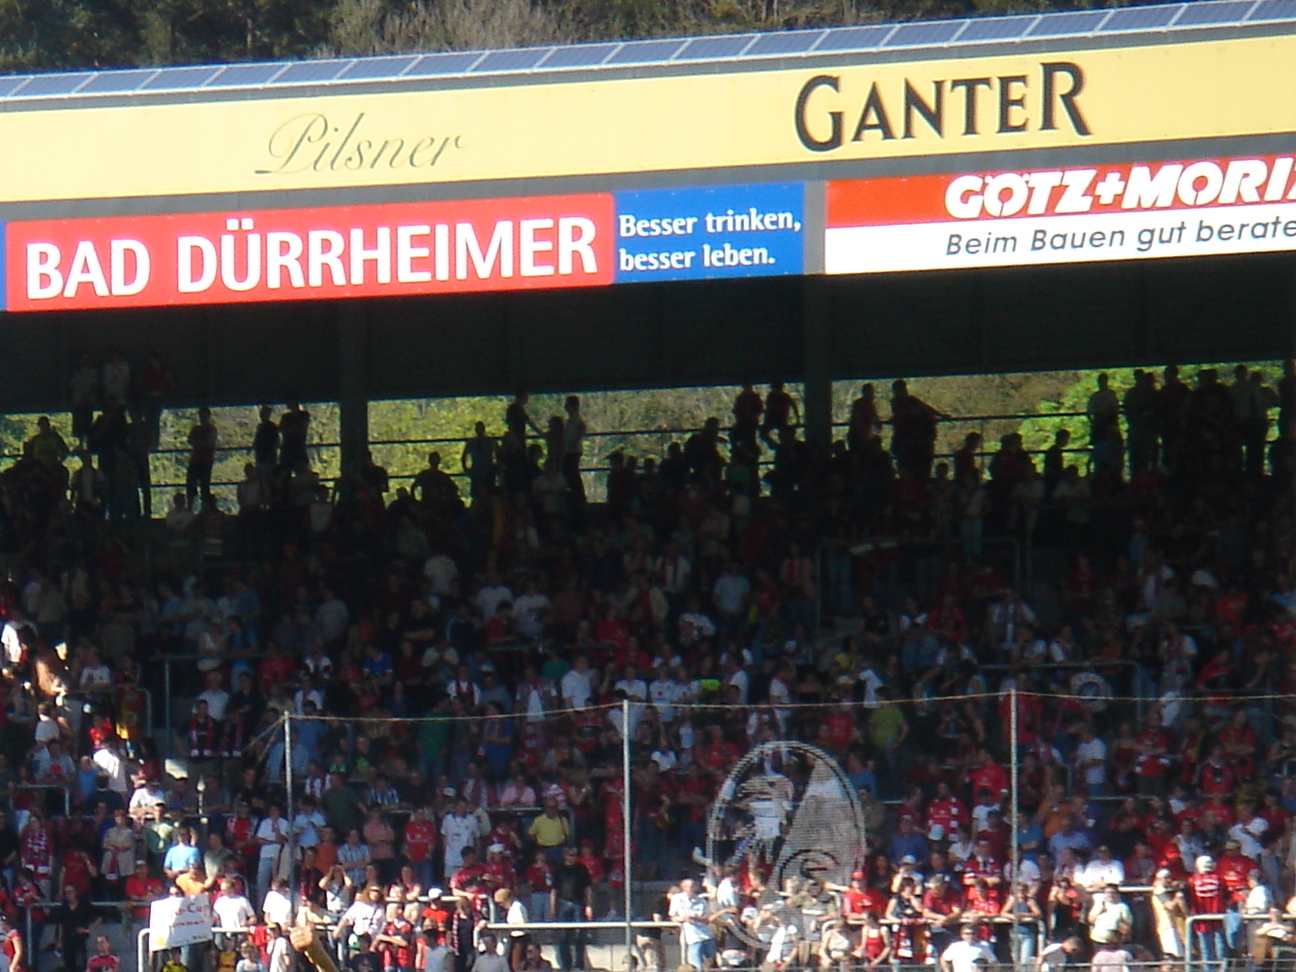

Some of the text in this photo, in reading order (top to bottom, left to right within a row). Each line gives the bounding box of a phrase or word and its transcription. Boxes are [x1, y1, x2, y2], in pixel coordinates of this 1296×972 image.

[794, 61, 1093, 152] GANTER
[254, 112, 469, 174] Pilsner
[618, 207, 801, 237] Besser trinken,
[946, 232, 1018, 256] Beim
[1030, 227, 1126, 252] Bauen
[1136, 220, 1187, 252] gut
[26, 216, 599, 300] BAD DÜRRHEIMER
[618, 243, 776, 271] besser leben.
